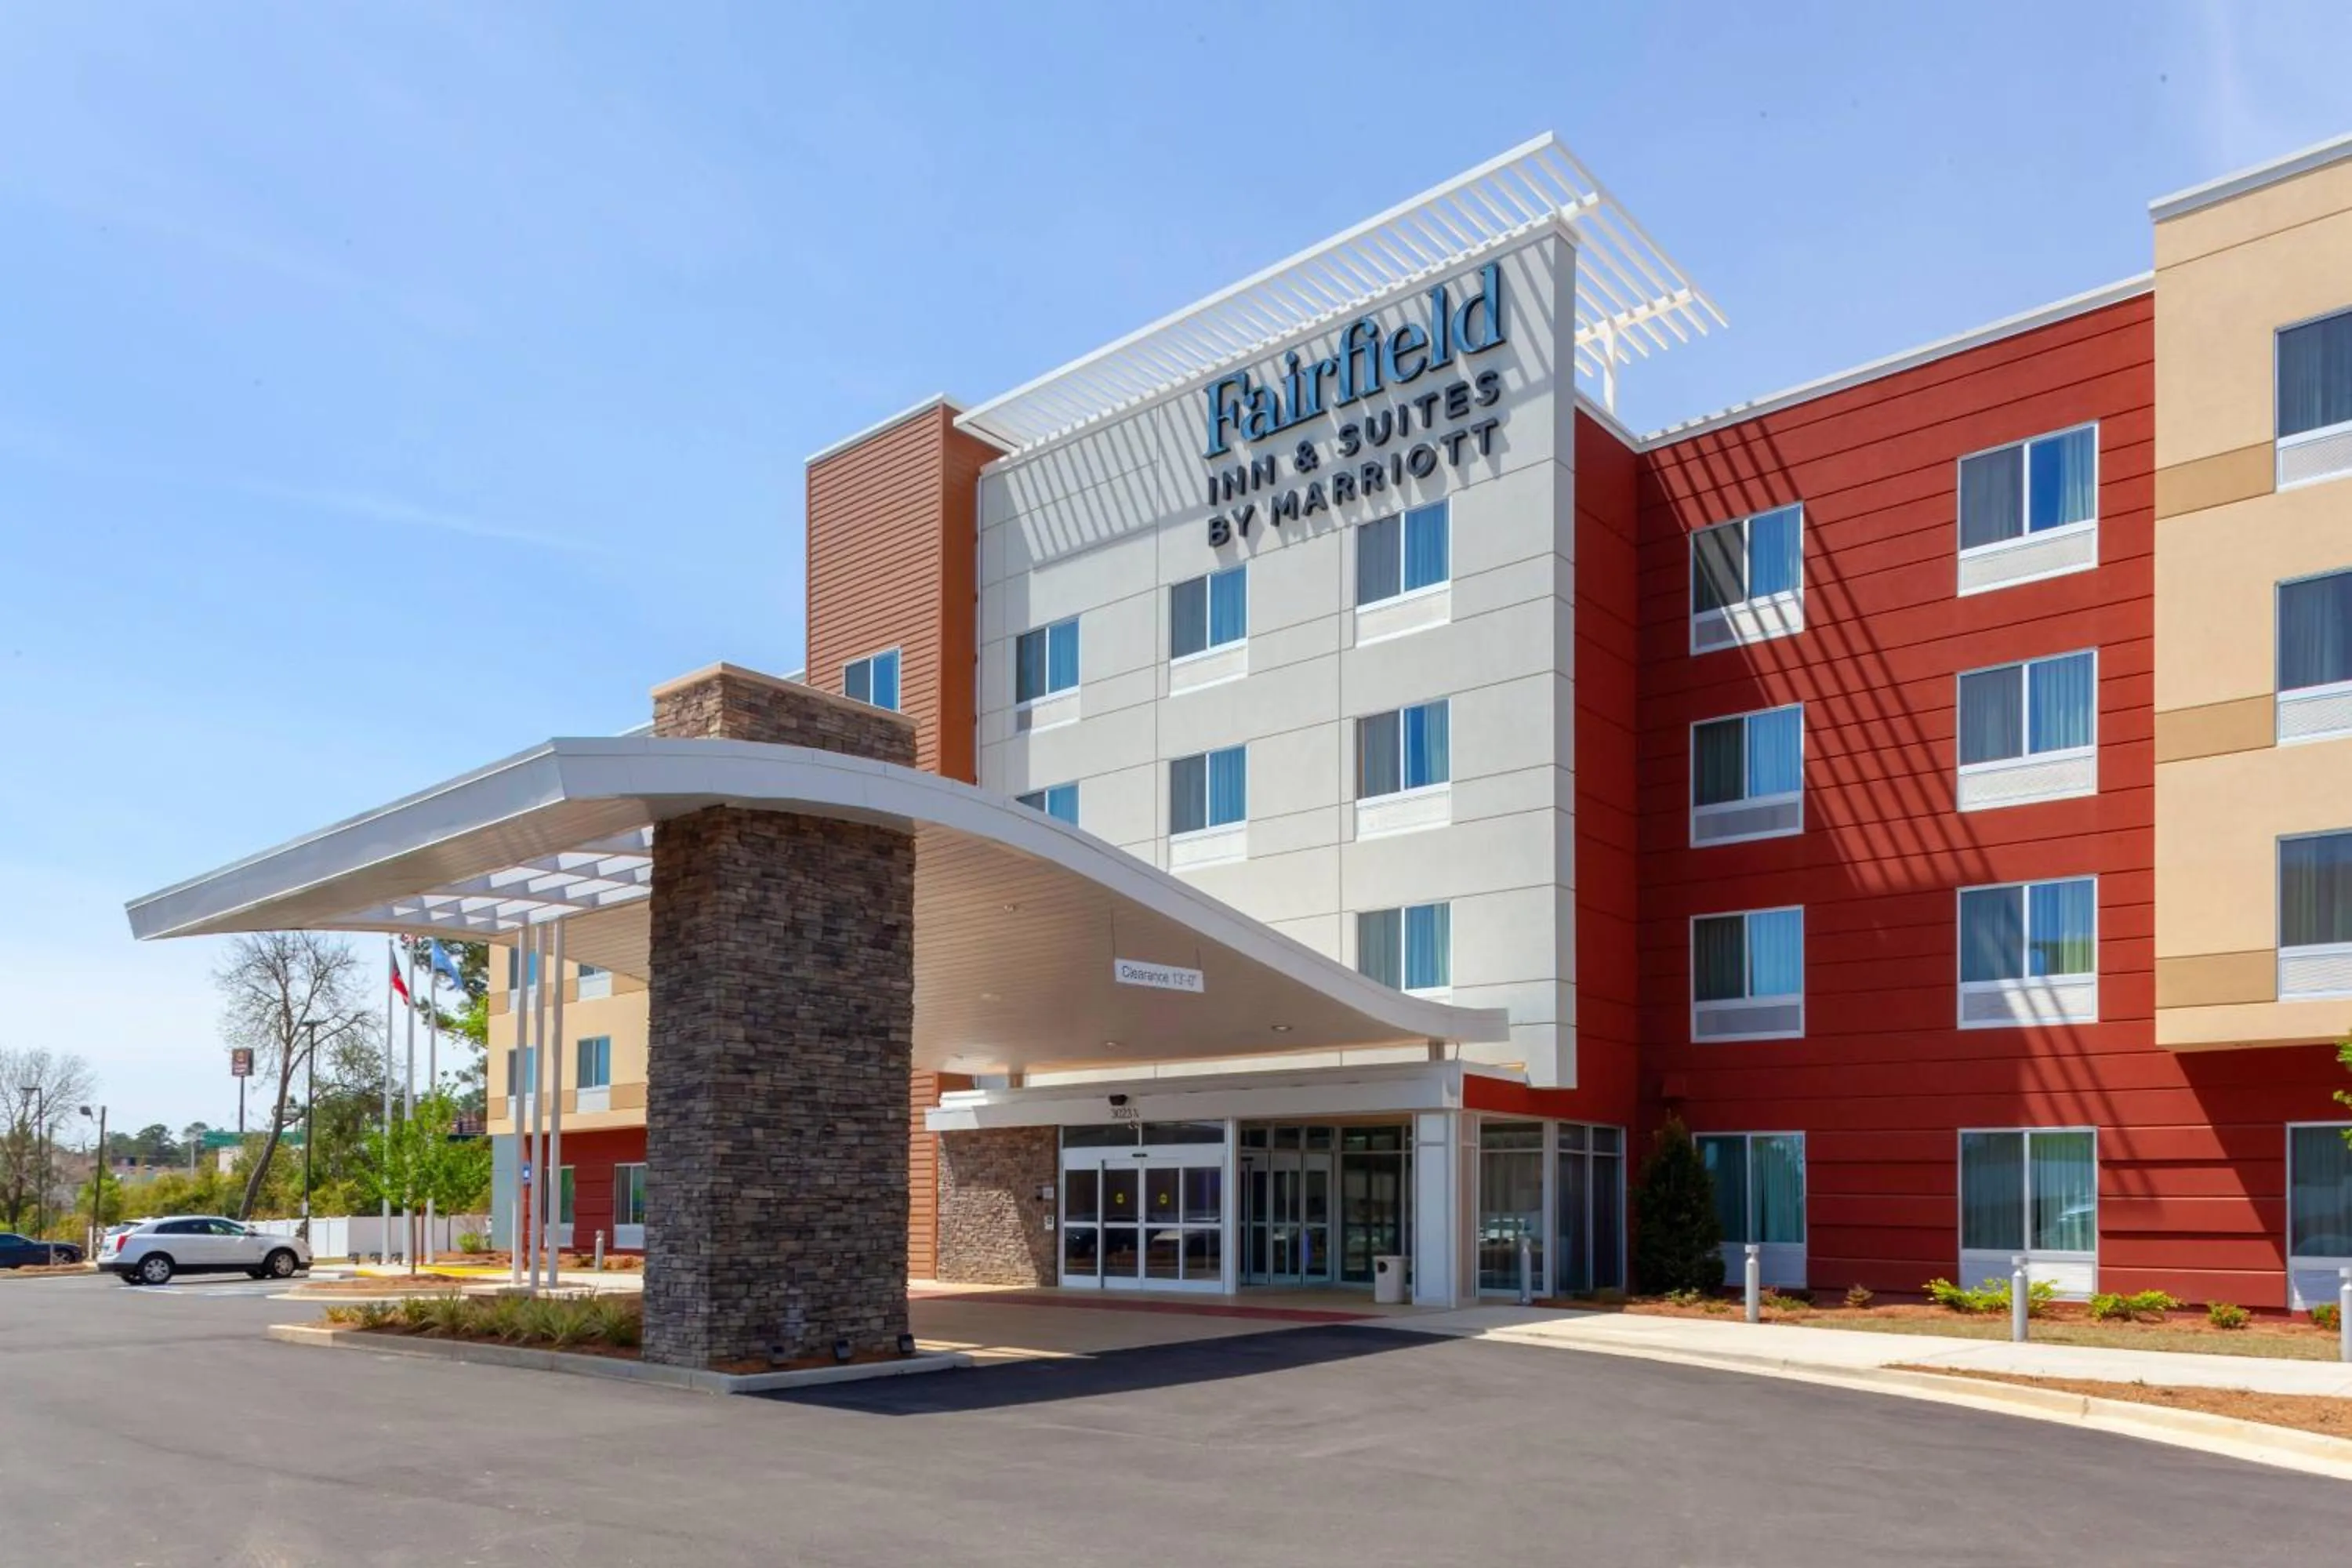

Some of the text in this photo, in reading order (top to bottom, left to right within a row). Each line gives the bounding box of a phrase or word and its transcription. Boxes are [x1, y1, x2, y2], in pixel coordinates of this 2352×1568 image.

[1203, 260, 1506, 460] Fairfield
[1208, 370, 1500, 506] INN & SUITES
[1208, 418, 1499, 547] BY MARRIOTT
[1122, 965, 1169, 983] Clearance
